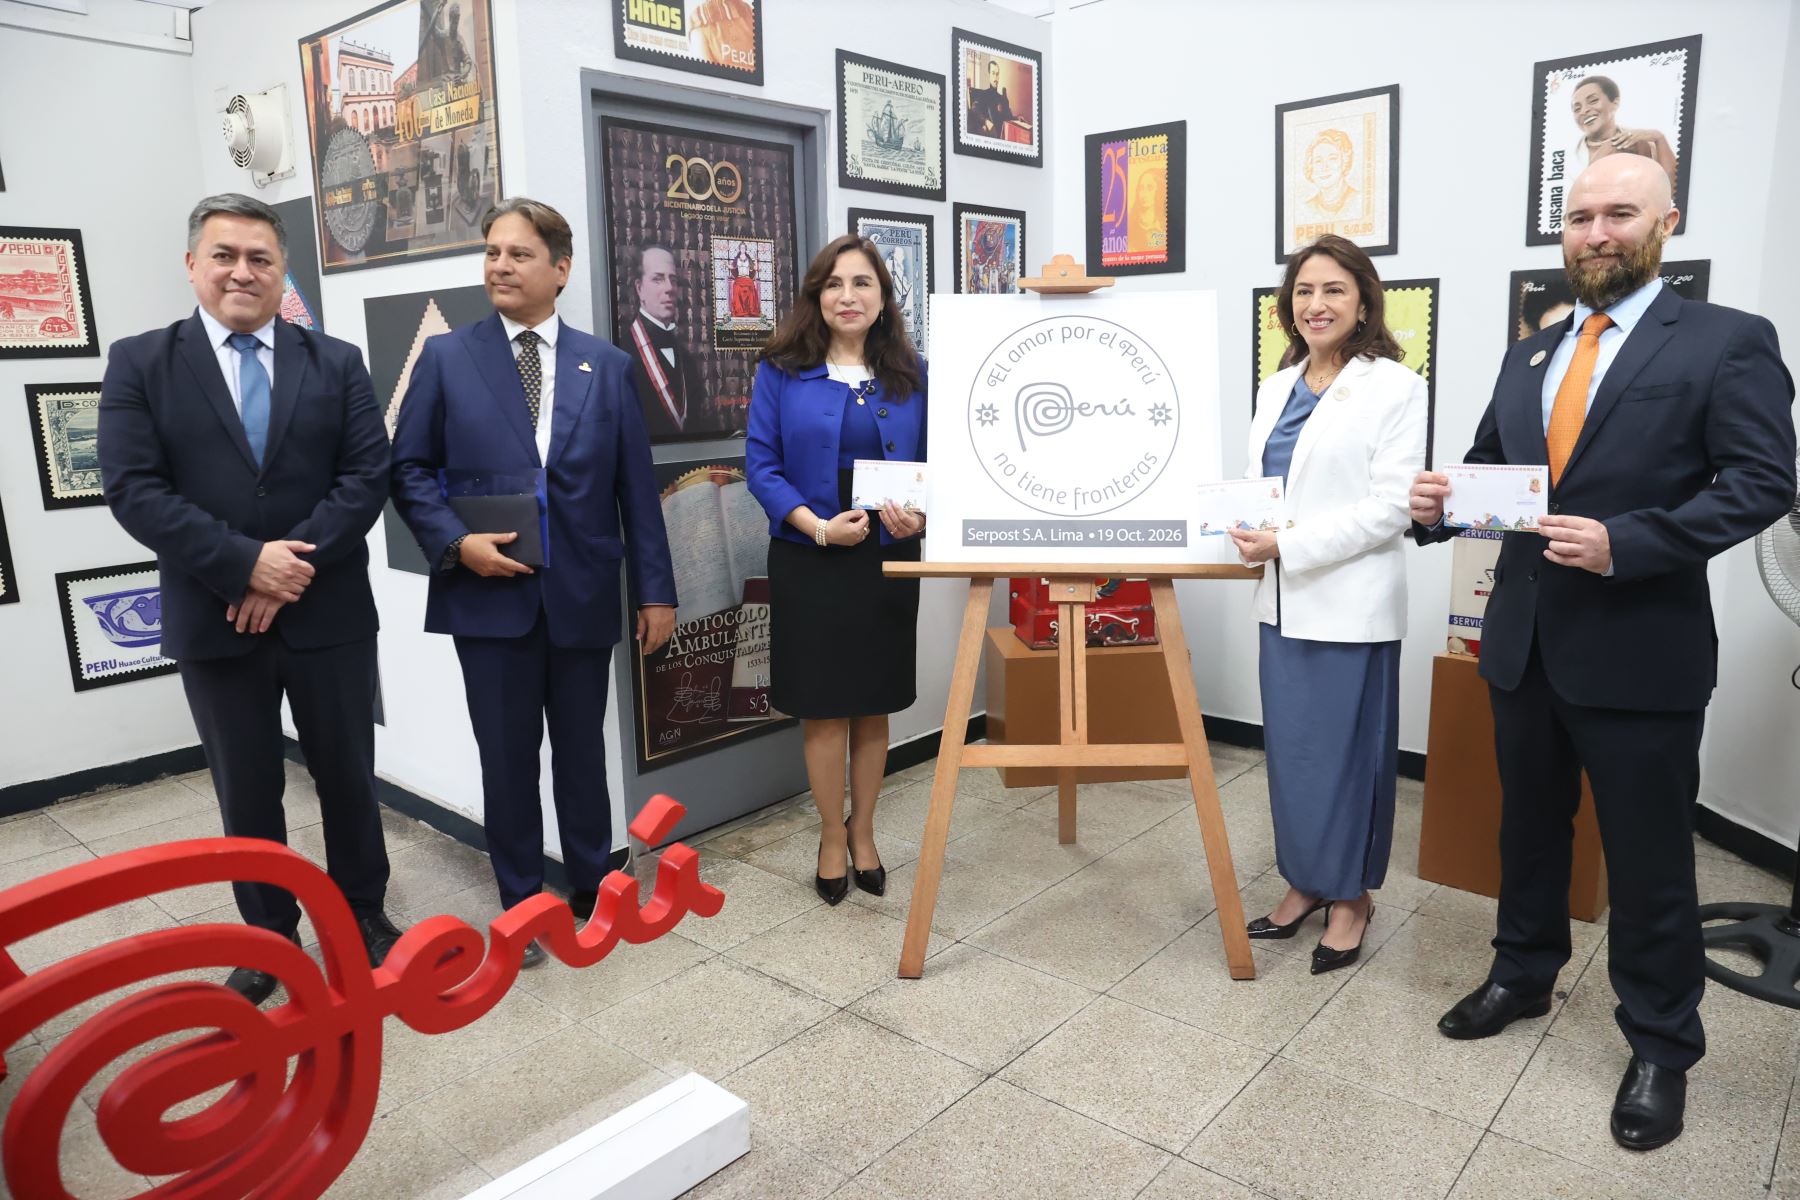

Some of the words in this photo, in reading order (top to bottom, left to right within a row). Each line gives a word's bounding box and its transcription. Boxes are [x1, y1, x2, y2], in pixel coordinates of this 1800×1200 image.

[429, 87, 446, 107] Casa
[447, 80, 480, 101] Nacional
[862, 71, 924, 96] PERU-AEREO
[395, 96, 424, 142] 460
[435, 110, 444, 128] de
[445, 101, 474, 125] Moneda
[1128, 141, 1167, 158] flora
[1547, 149, 1566, 181] baca
[665, 154, 742, 204] 200
[717, 176, 736, 187] años
[1103, 146, 1127, 228] 25
[664, 199, 706, 211] BICENTENARIO
[722, 206, 746, 215] JUSTICIA
[681, 211, 703, 221] Legado
[1549, 185, 1564, 230] susana
[9, 243, 41, 255] PERU
[881, 236, 913, 245] CORREOS
[1103, 228, 1128, 254] años
[1522, 282, 1546, 293] Perú
[987, 363, 1012, 387] El
[1008, 328, 1054, 363] amor
[1061, 326, 1095, 344] por
[1099, 332, 1118, 349] el
[1118, 339, 1161, 385] Perú
[1014, 381, 1136, 452] Perú
[994, 452, 1017, 476] no
[1017, 471, 1067, 505] tiene
[1074, 451, 1158, 511] fronteras
[967, 528, 1020, 544] Serpost
[1022, 528, 1047, 542] S.A.
[1050, 528, 1084, 542] Lima
[1098, 529, 1114, 542] 19
[1116, 529, 1145, 542] Oct.
[1148, 529, 1182, 542] 2026
[86, 659, 117, 674] PERU
[118, 659, 141, 668] Huaco
[656, 663, 667, 673] DE
[668, 660, 682, 671] LOS
[659, 728, 681, 742] AGN
